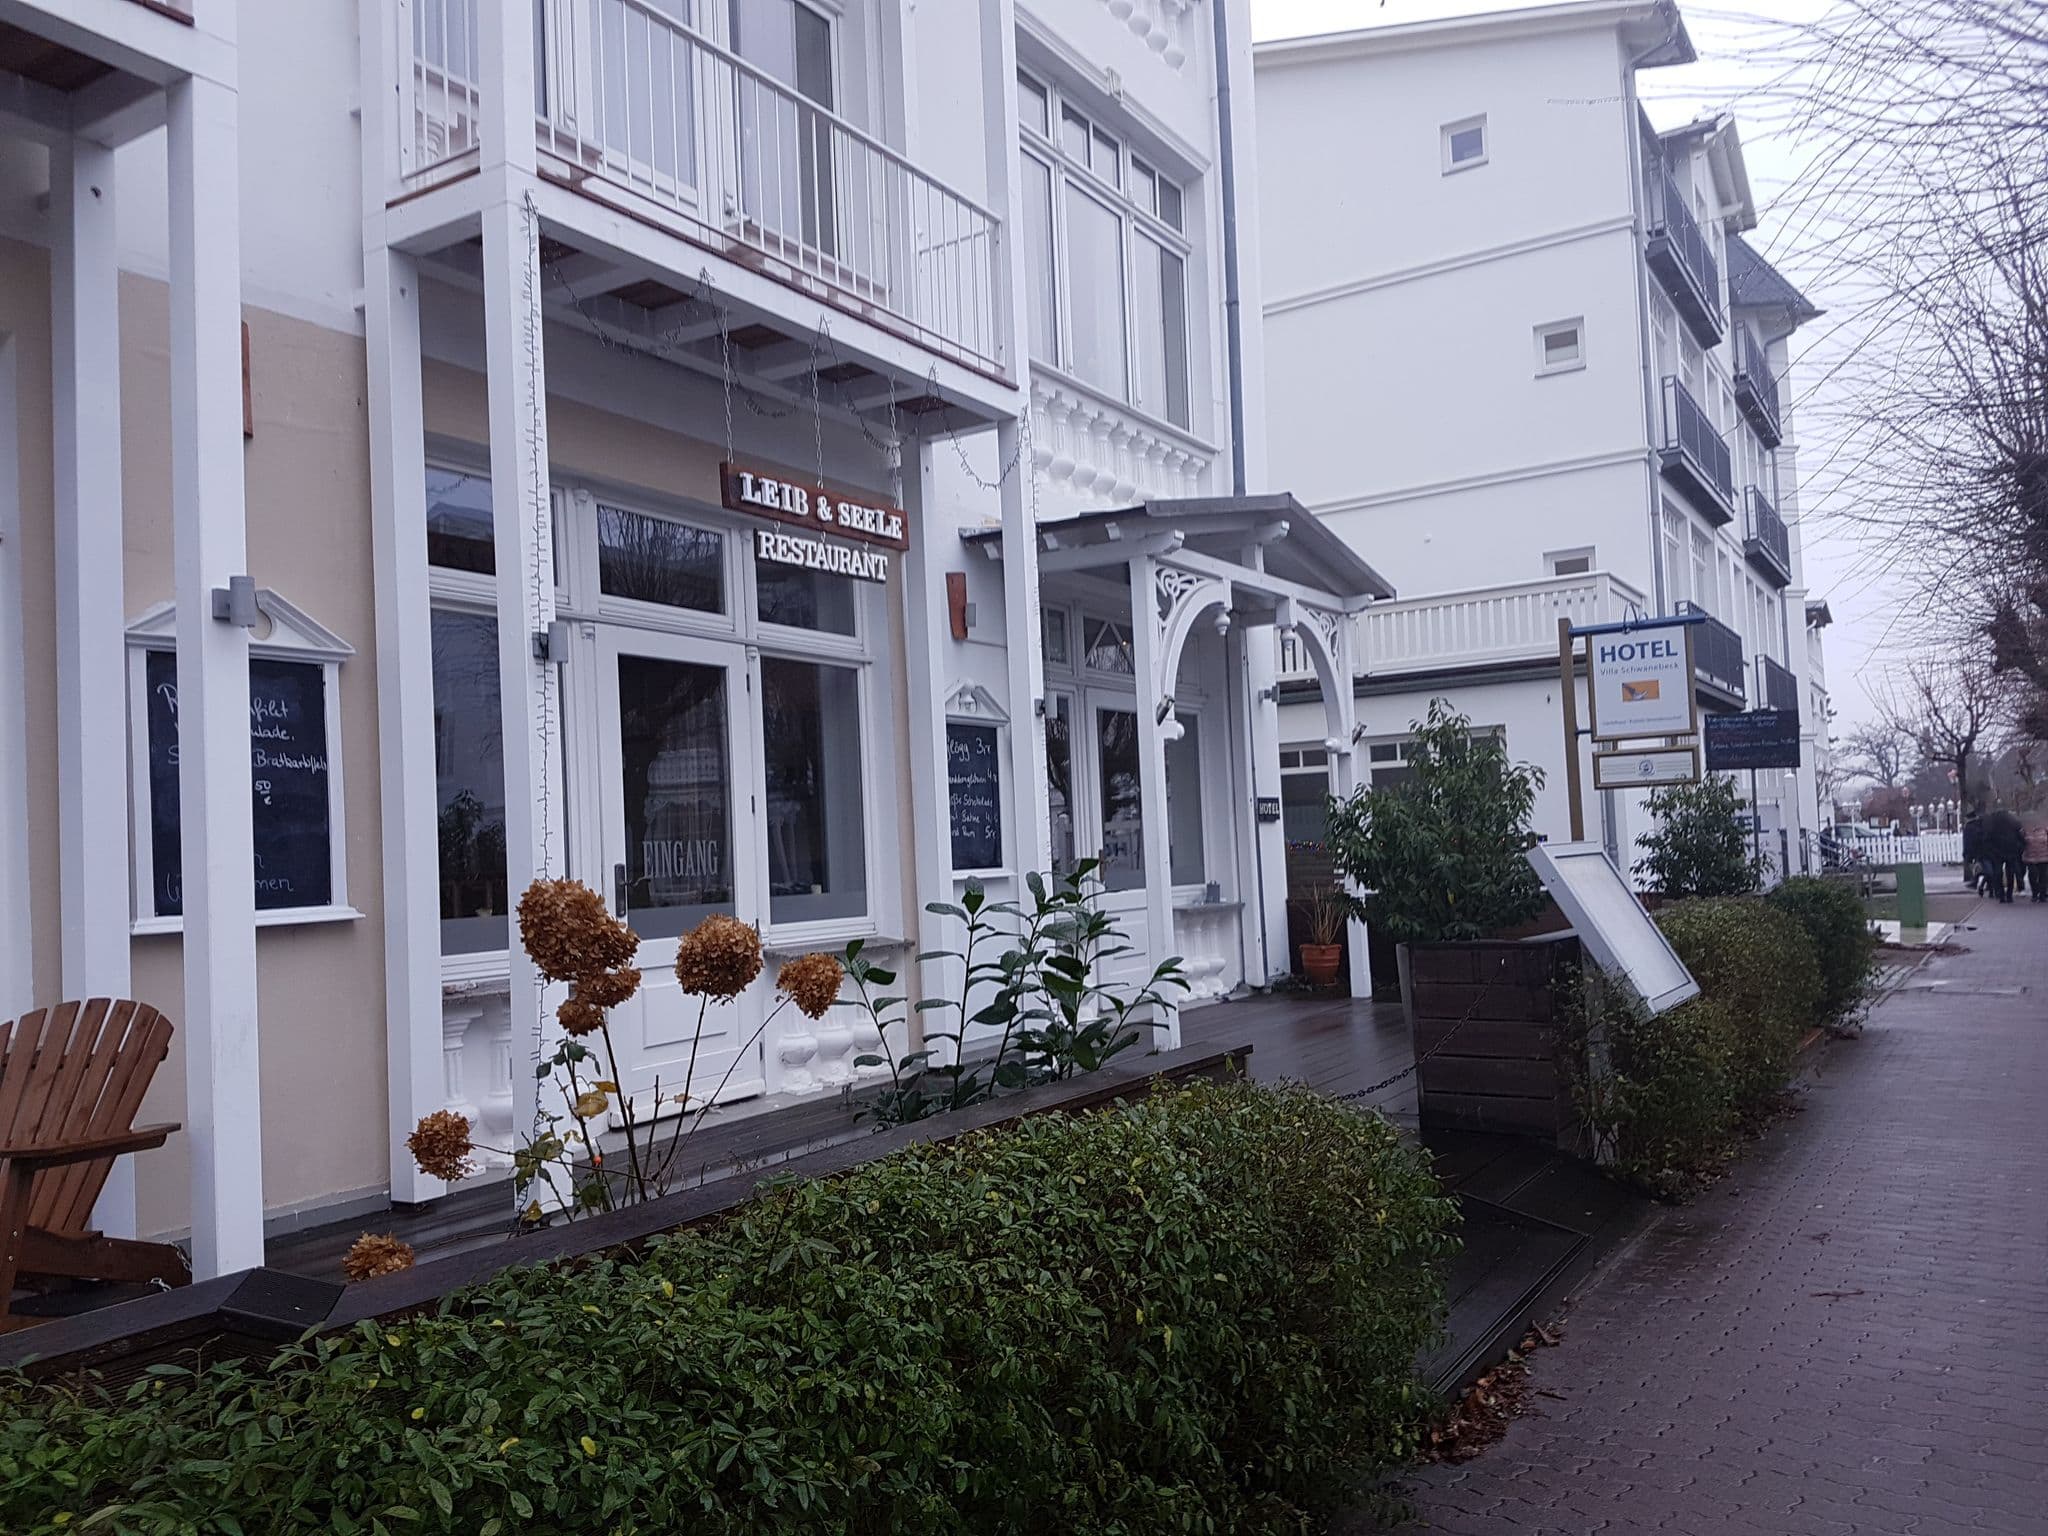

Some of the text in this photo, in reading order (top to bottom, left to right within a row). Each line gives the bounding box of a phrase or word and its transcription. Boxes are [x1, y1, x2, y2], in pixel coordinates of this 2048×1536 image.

[739, 472, 902, 540] LEIB & SEELE
[758, 530, 888, 581] RESTAURANT
[1601, 639, 1678, 662] HOTEL
[1259, 802, 1280, 815] HOTEL
[642, 840, 718, 879] EINGANG
